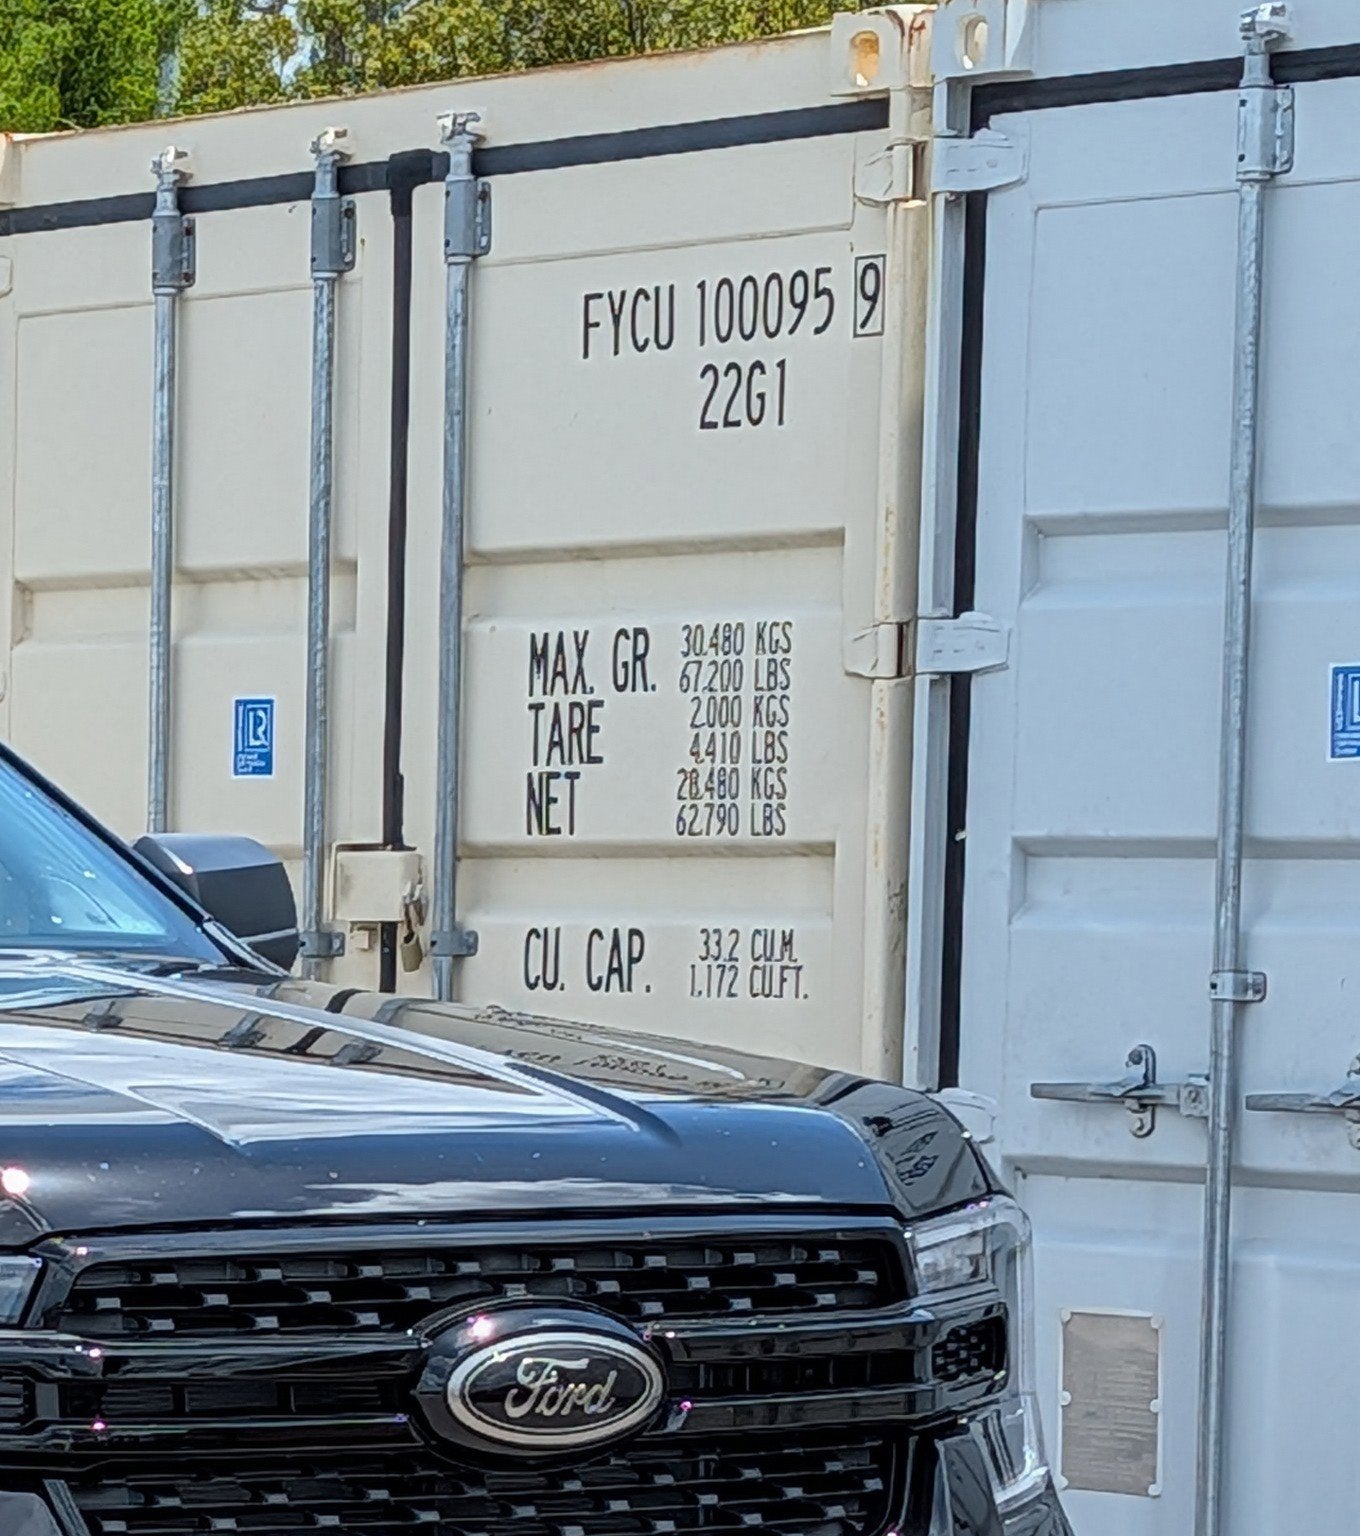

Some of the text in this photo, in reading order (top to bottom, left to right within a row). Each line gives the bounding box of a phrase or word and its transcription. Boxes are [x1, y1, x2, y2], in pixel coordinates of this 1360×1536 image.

[582, 261, 881, 360] FYCU 100095 9
[699, 357, 787, 430] 22G1
[612, 626, 657, 694] GR.
[755, 620, 793, 656] KGS
[754, 657, 792, 693] LBS
[527, 700, 605, 767] TARE
[752, 694, 791, 729] KGS
[751, 730, 789, 765] LBS
[526, 771, 581, 836] NET
[750, 766, 788, 801] KGS
[749, 803, 787, 837] LBS
[524, 927, 565, 992] CU.
[585, 927, 651, 993] CAP.
[698, 927, 740, 963] 33.2
[504, 1356, 618, 1419] Ford
